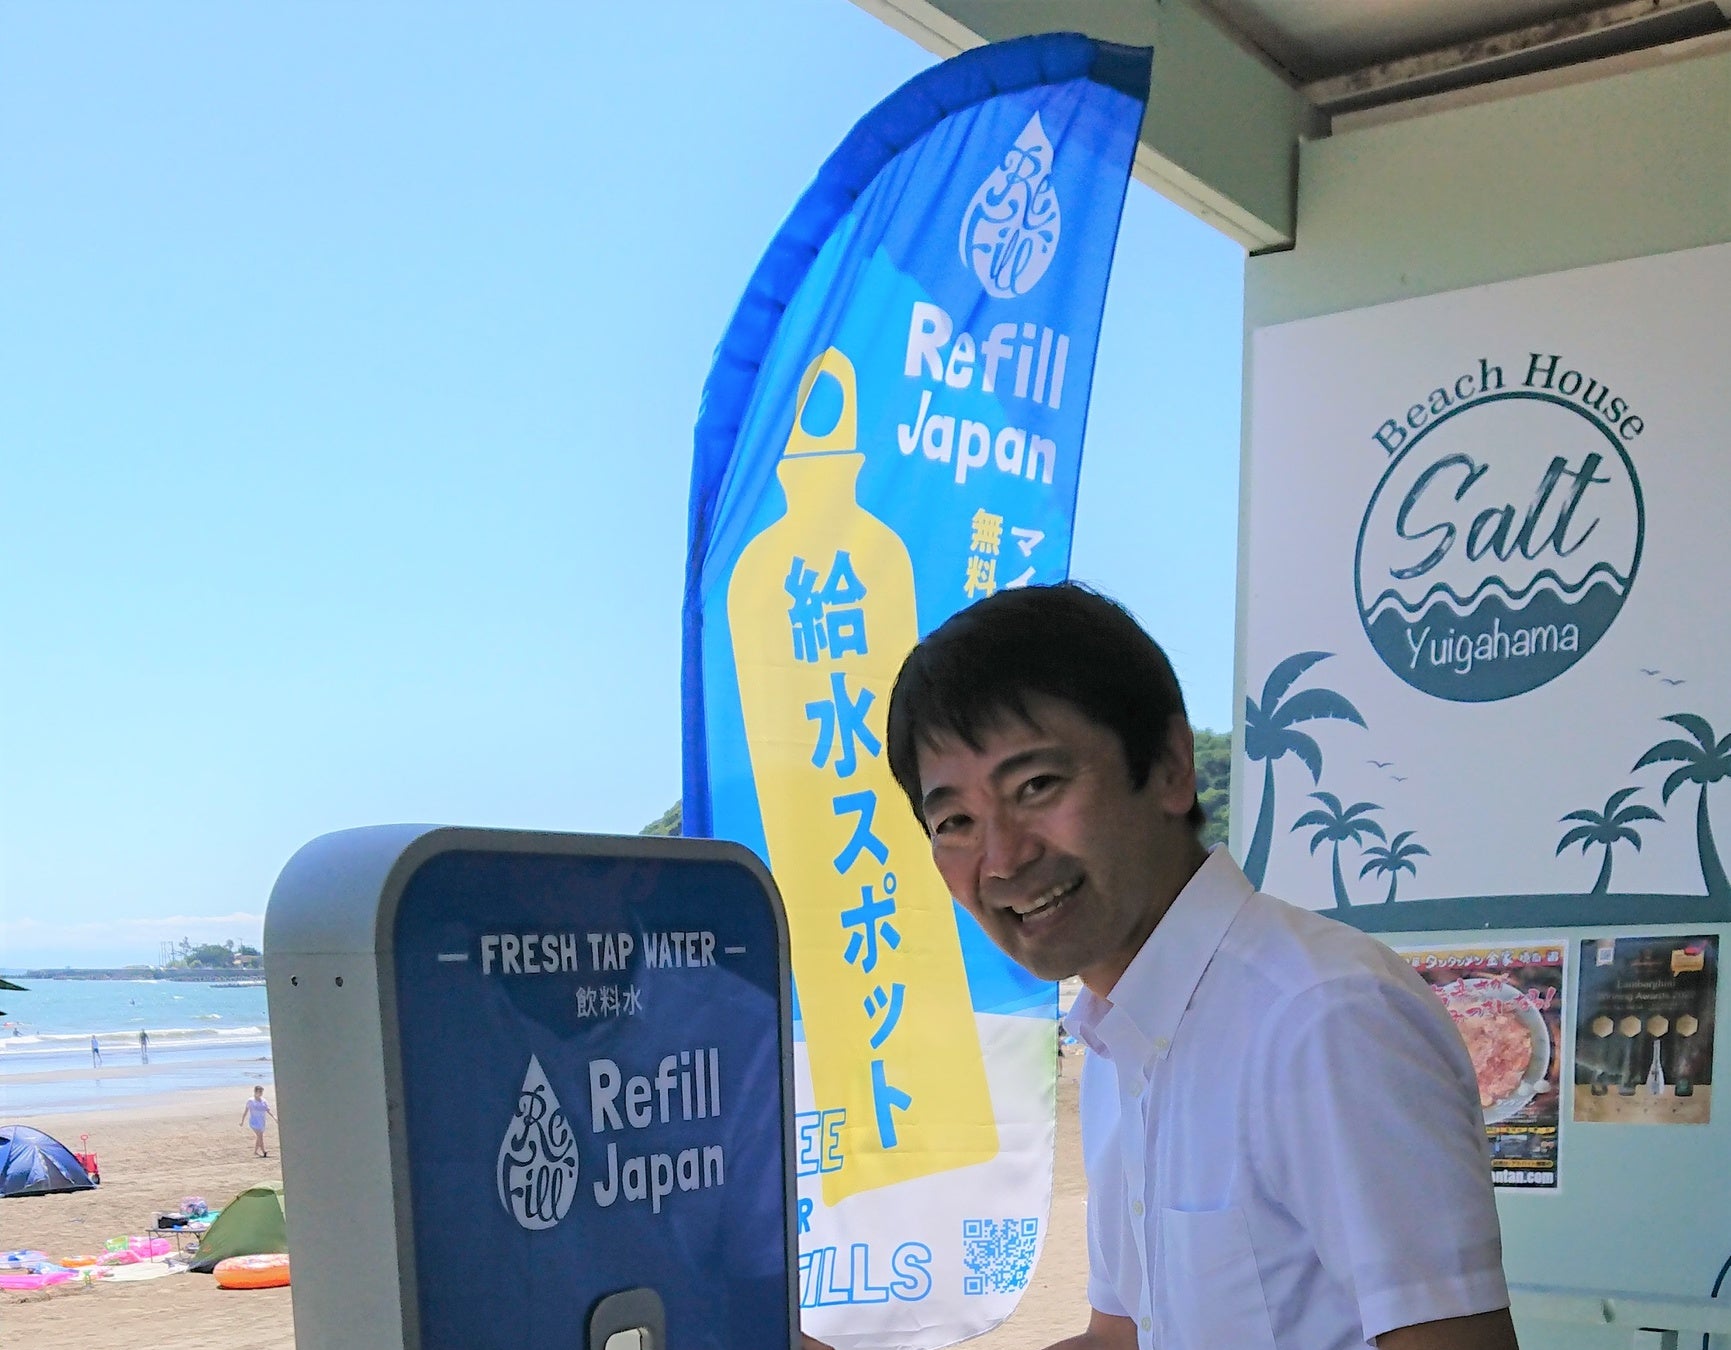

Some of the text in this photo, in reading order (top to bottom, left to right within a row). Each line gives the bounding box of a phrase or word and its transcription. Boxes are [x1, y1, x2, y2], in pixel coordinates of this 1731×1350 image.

[904, 301, 1069, 409] Refill
[898, 398, 1056, 485] Japan
[1372, 353, 1645, 455] Beach House
[1390, 453, 1611, 579] Salt
[1406, 618, 1579, 674] Yuigahama
[784, 549, 912, 1149] 給水スポット
[481, 931, 716, 975] FRESH TAP WATER
[576, 984, 643, 1018] 飲料水
[589, 1047, 721, 1134] Refill
[592, 1142, 724, 1215] Japan
